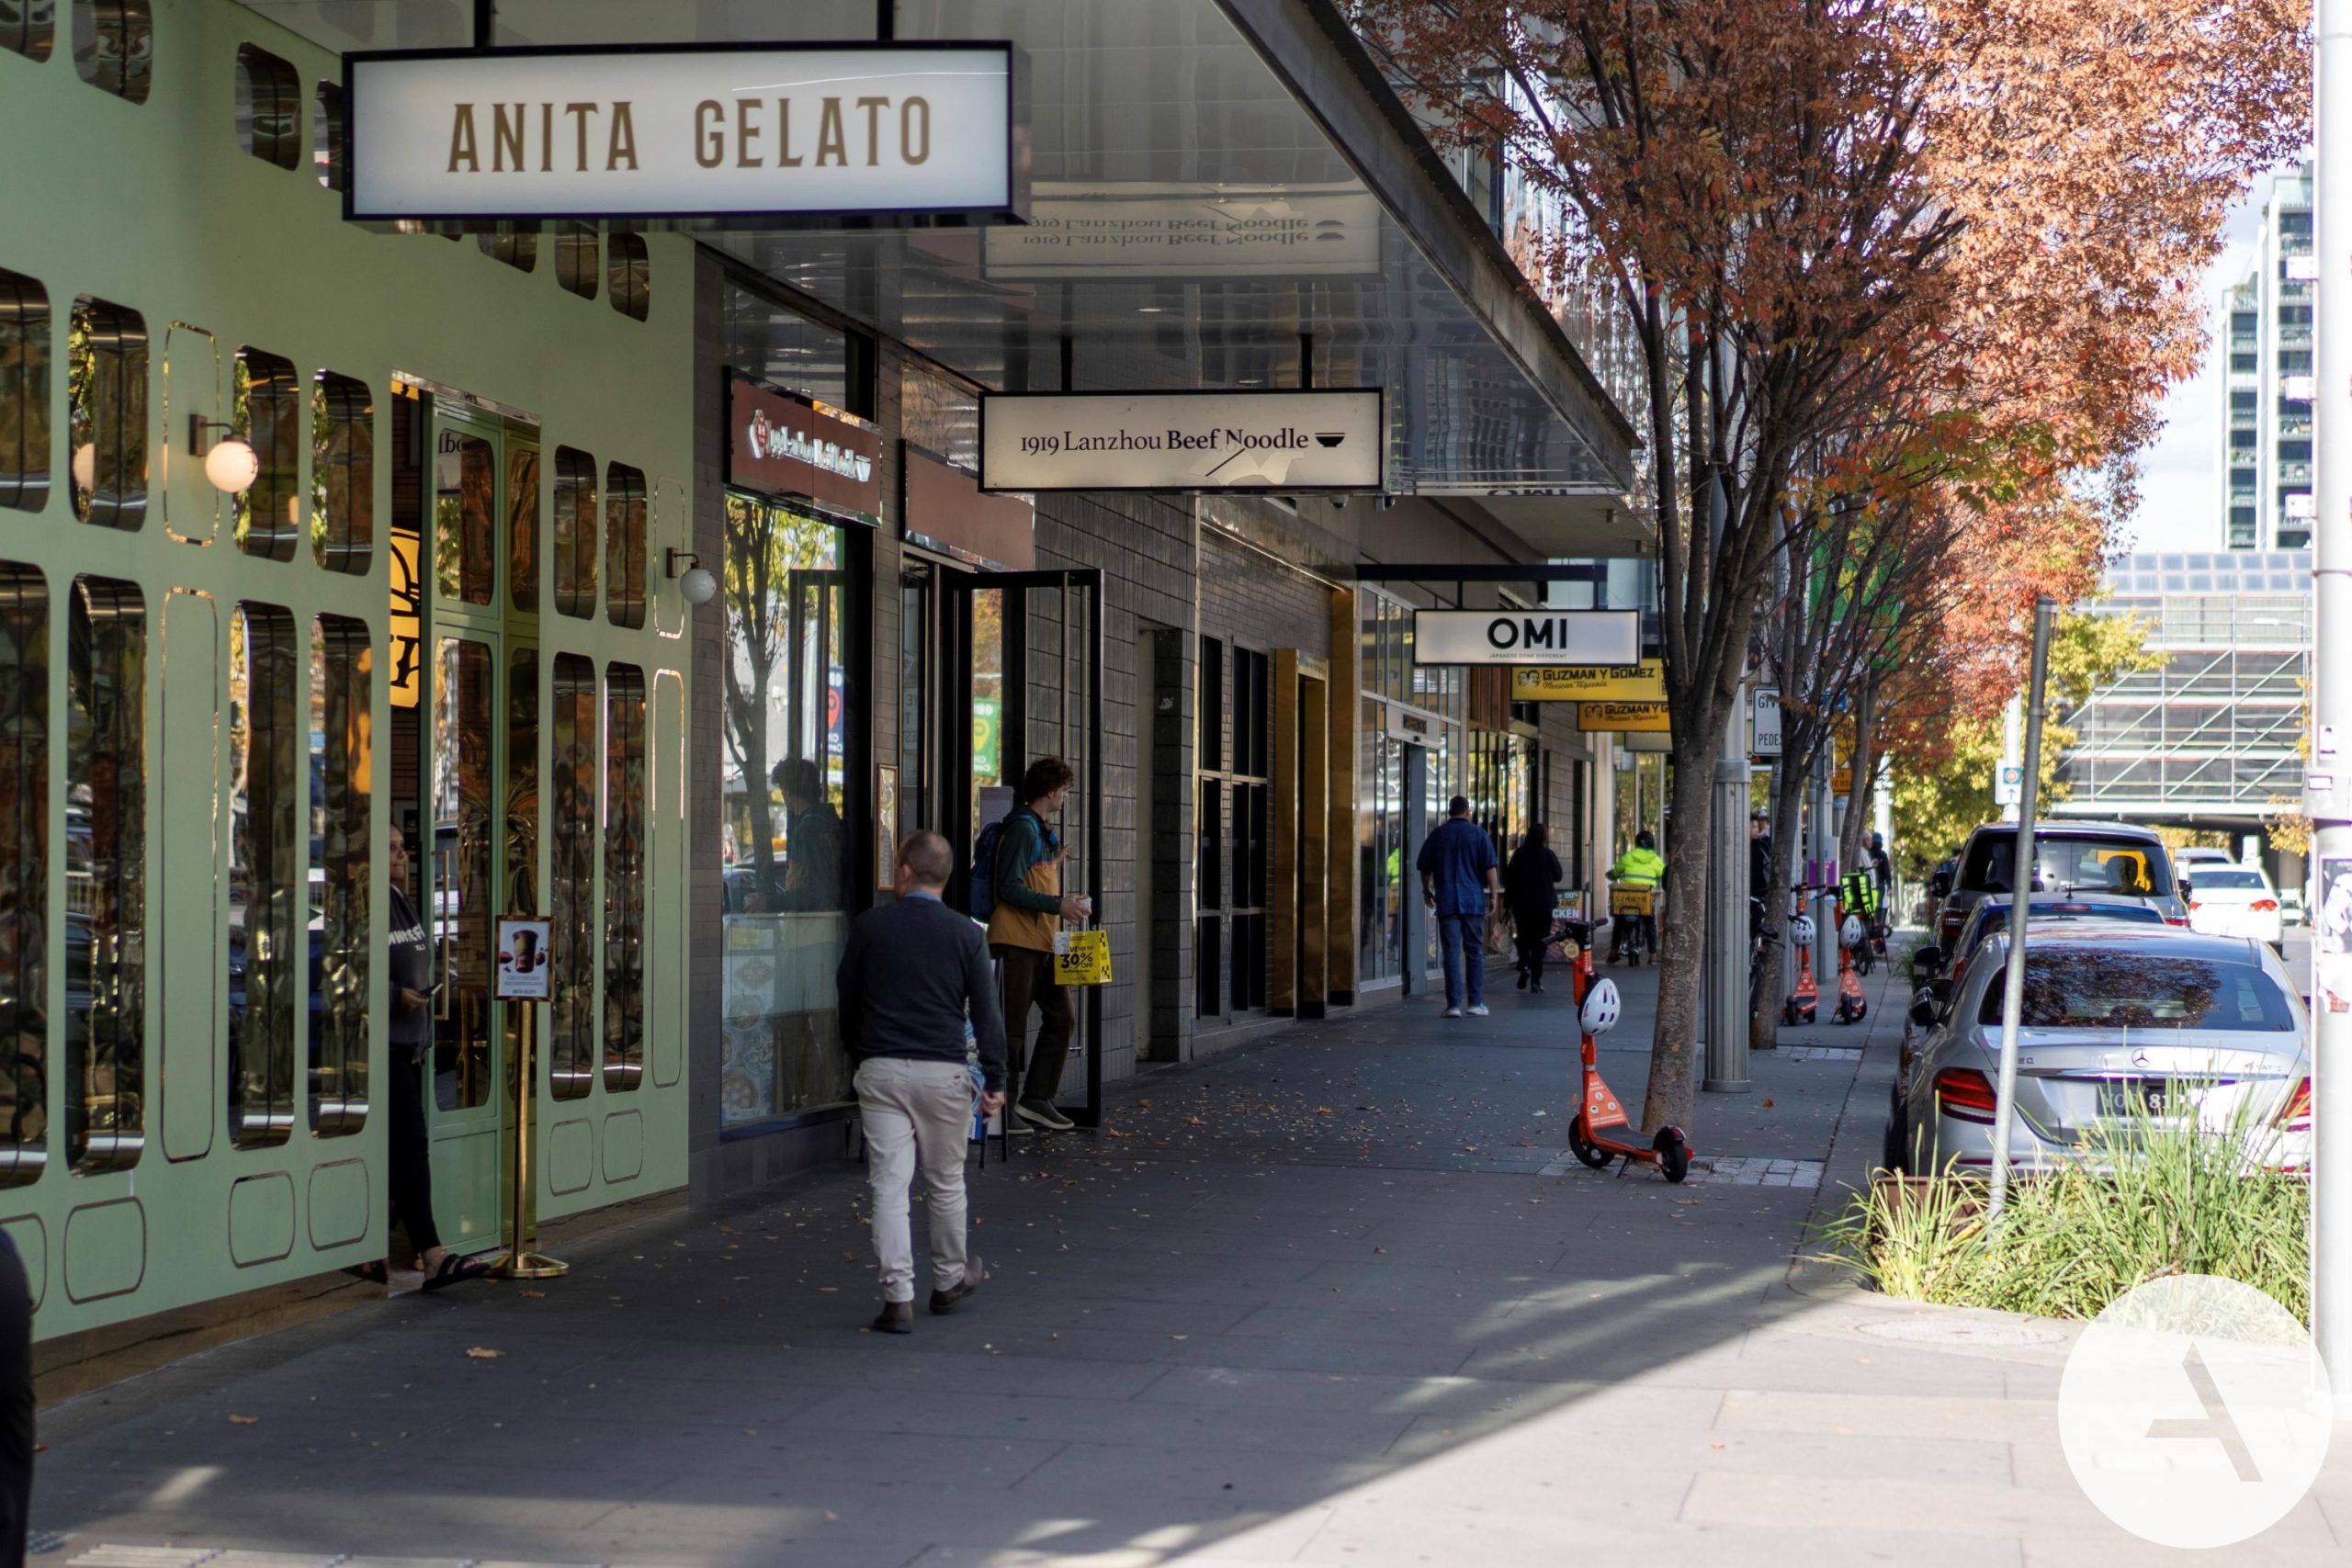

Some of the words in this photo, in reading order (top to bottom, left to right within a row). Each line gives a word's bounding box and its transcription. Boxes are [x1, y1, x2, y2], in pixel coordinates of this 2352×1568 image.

[447, 101, 639, 173] ANITA
[695, 96, 930, 168] GELATO
[1021, 435, 1059, 456] 1919
[1063, 429, 1162, 451] Lanzhou
[1166, 428, 1221, 450] Beef
[1225, 427, 1309, 452] Noodle
[1487, 617, 1567, 649] OMI
[1543, 669, 1596, 681] GUZMAN
[1599, 669, 1608, 679] Y
[1610, 667, 1655, 679] GOMEZ
[1543, 682, 1574, 690] Mexican
[1605, 705, 1649, 715] GUZMAN
[1651, 705, 1658, 713] Y
[1552, 908, 1579, 919] CKEN
[1059, 952, 1093, 969] 30%
